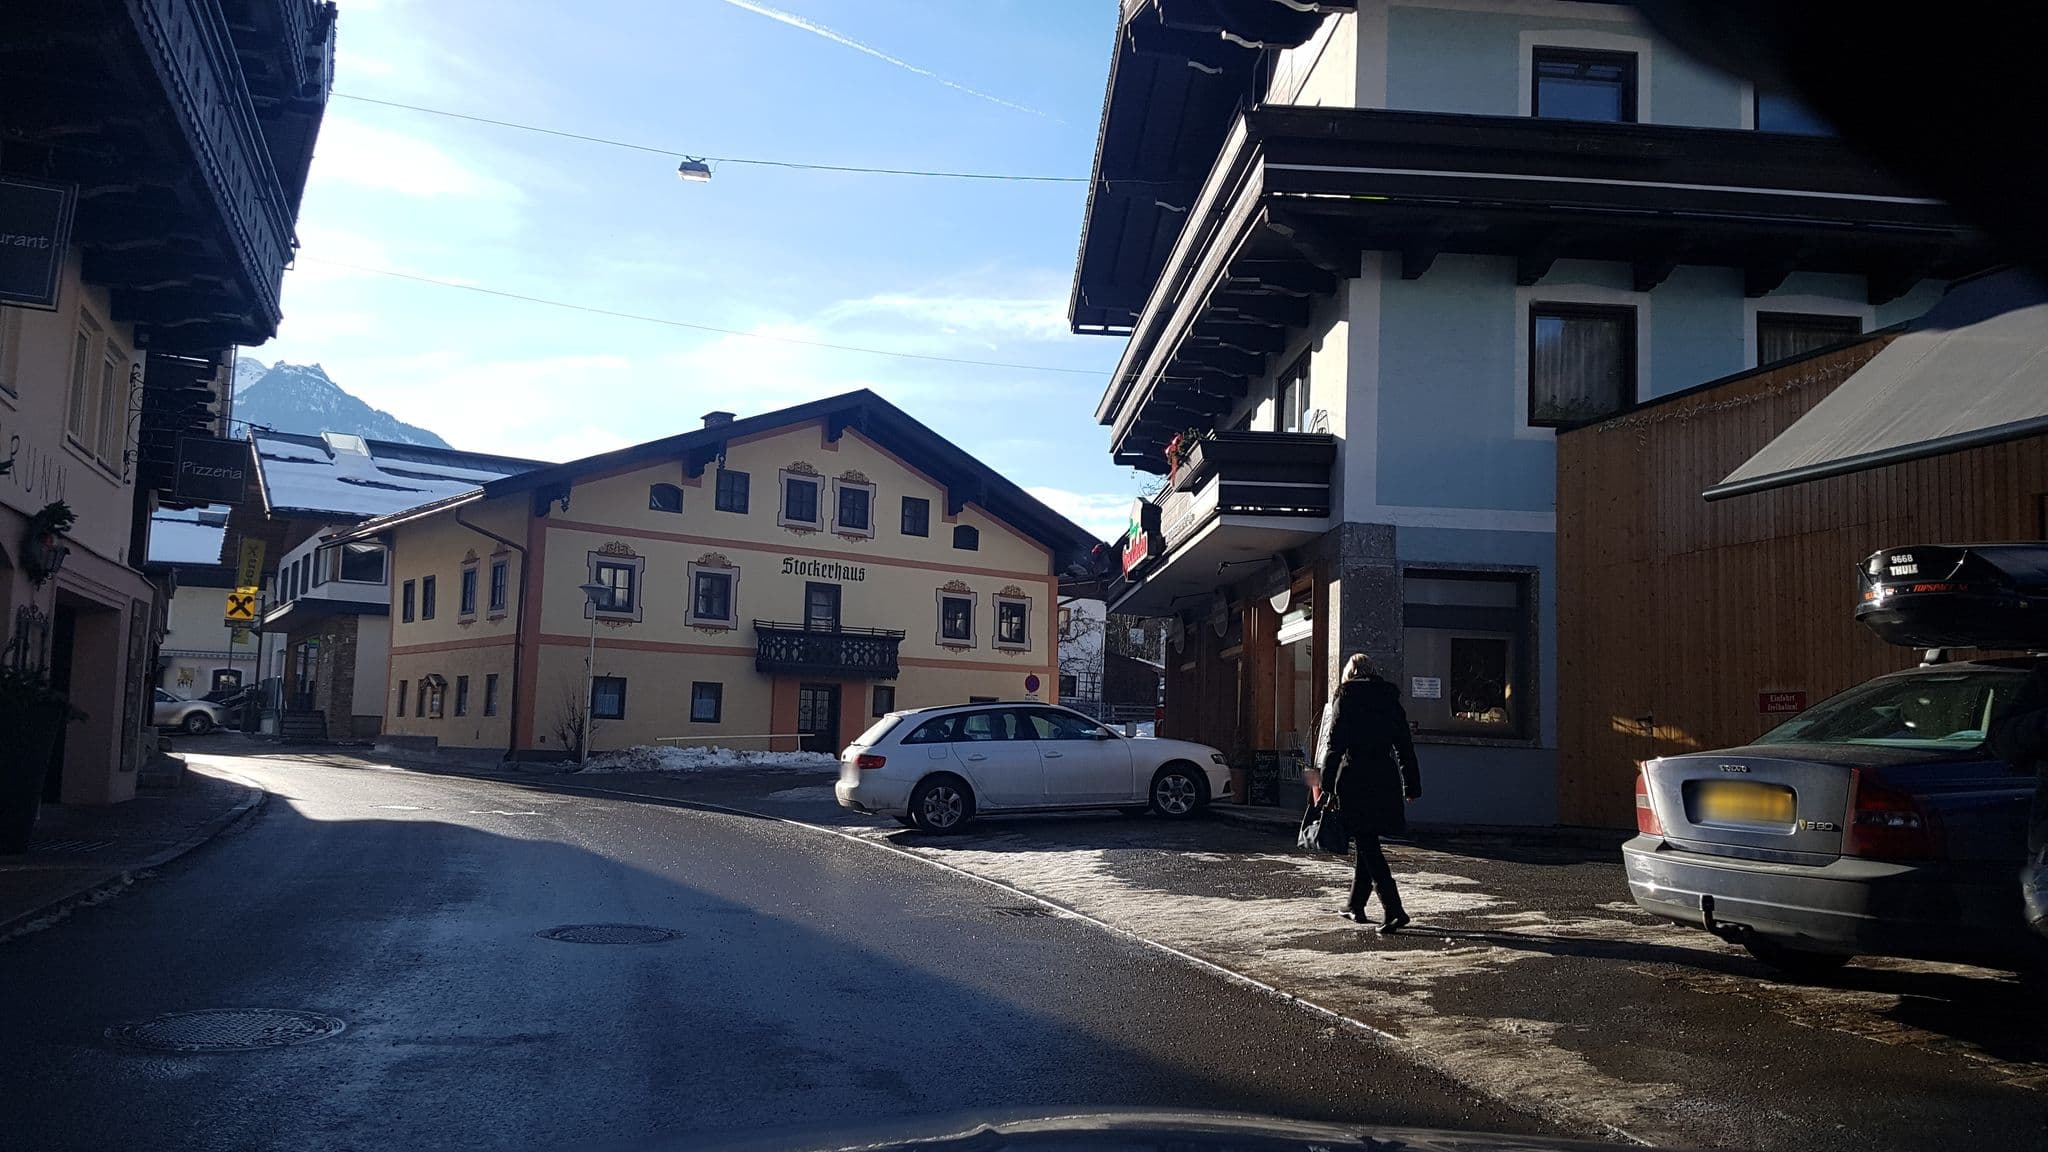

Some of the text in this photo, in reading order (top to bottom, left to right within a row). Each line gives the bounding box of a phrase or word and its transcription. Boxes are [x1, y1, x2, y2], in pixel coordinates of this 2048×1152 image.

[181, 461, 242, 480] Pizzeria
[781, 556, 866, 582] Stockerhaus
[1889, 563, 1919, 577] THULE
